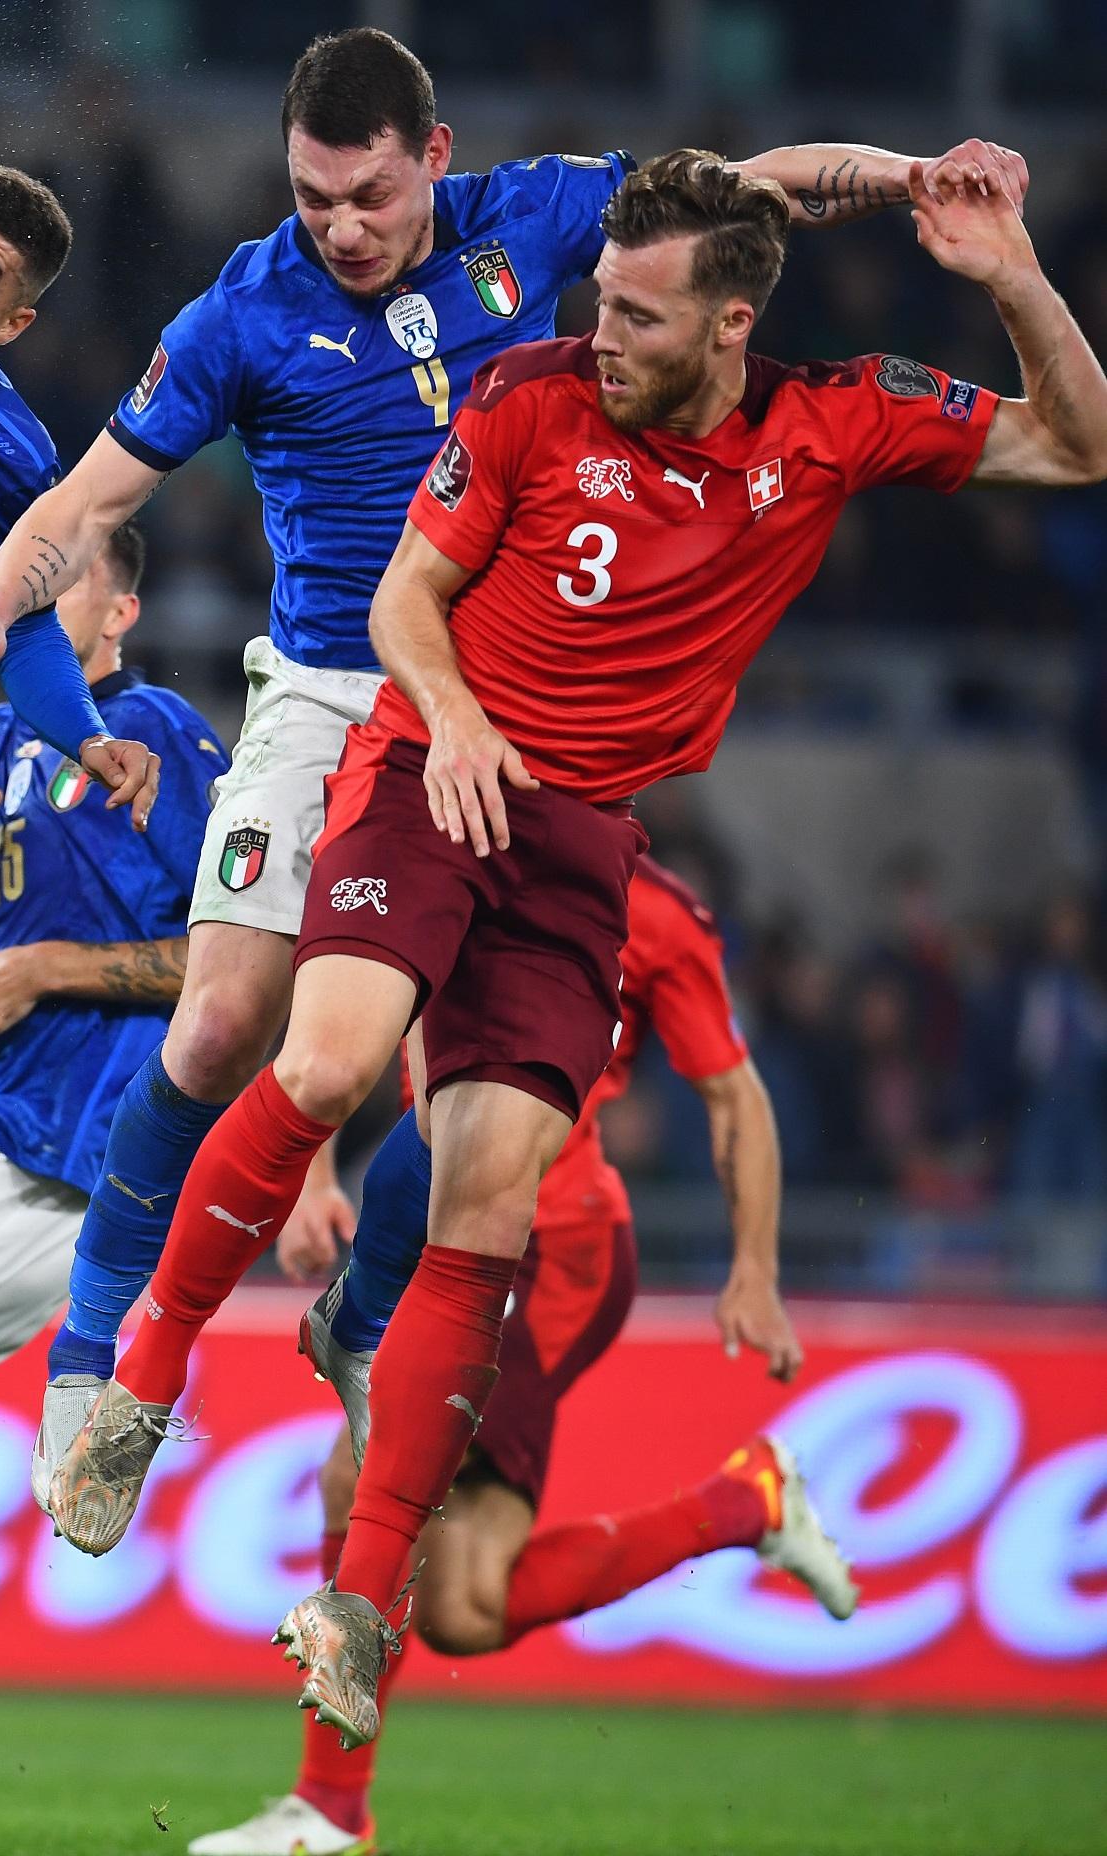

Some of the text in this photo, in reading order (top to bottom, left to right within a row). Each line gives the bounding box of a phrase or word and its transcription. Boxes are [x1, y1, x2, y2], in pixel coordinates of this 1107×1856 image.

[469, 254, 504, 278] ITALIA
[392, 303, 423, 319] EUROPEAN
[395, 309, 425, 324] CHAMPIONS
[416, 344, 432, 354] 2020
[411, 357, 450, 427] 4
[556, 522, 618, 607] 3
[228, 832, 266, 845] ITALIA
